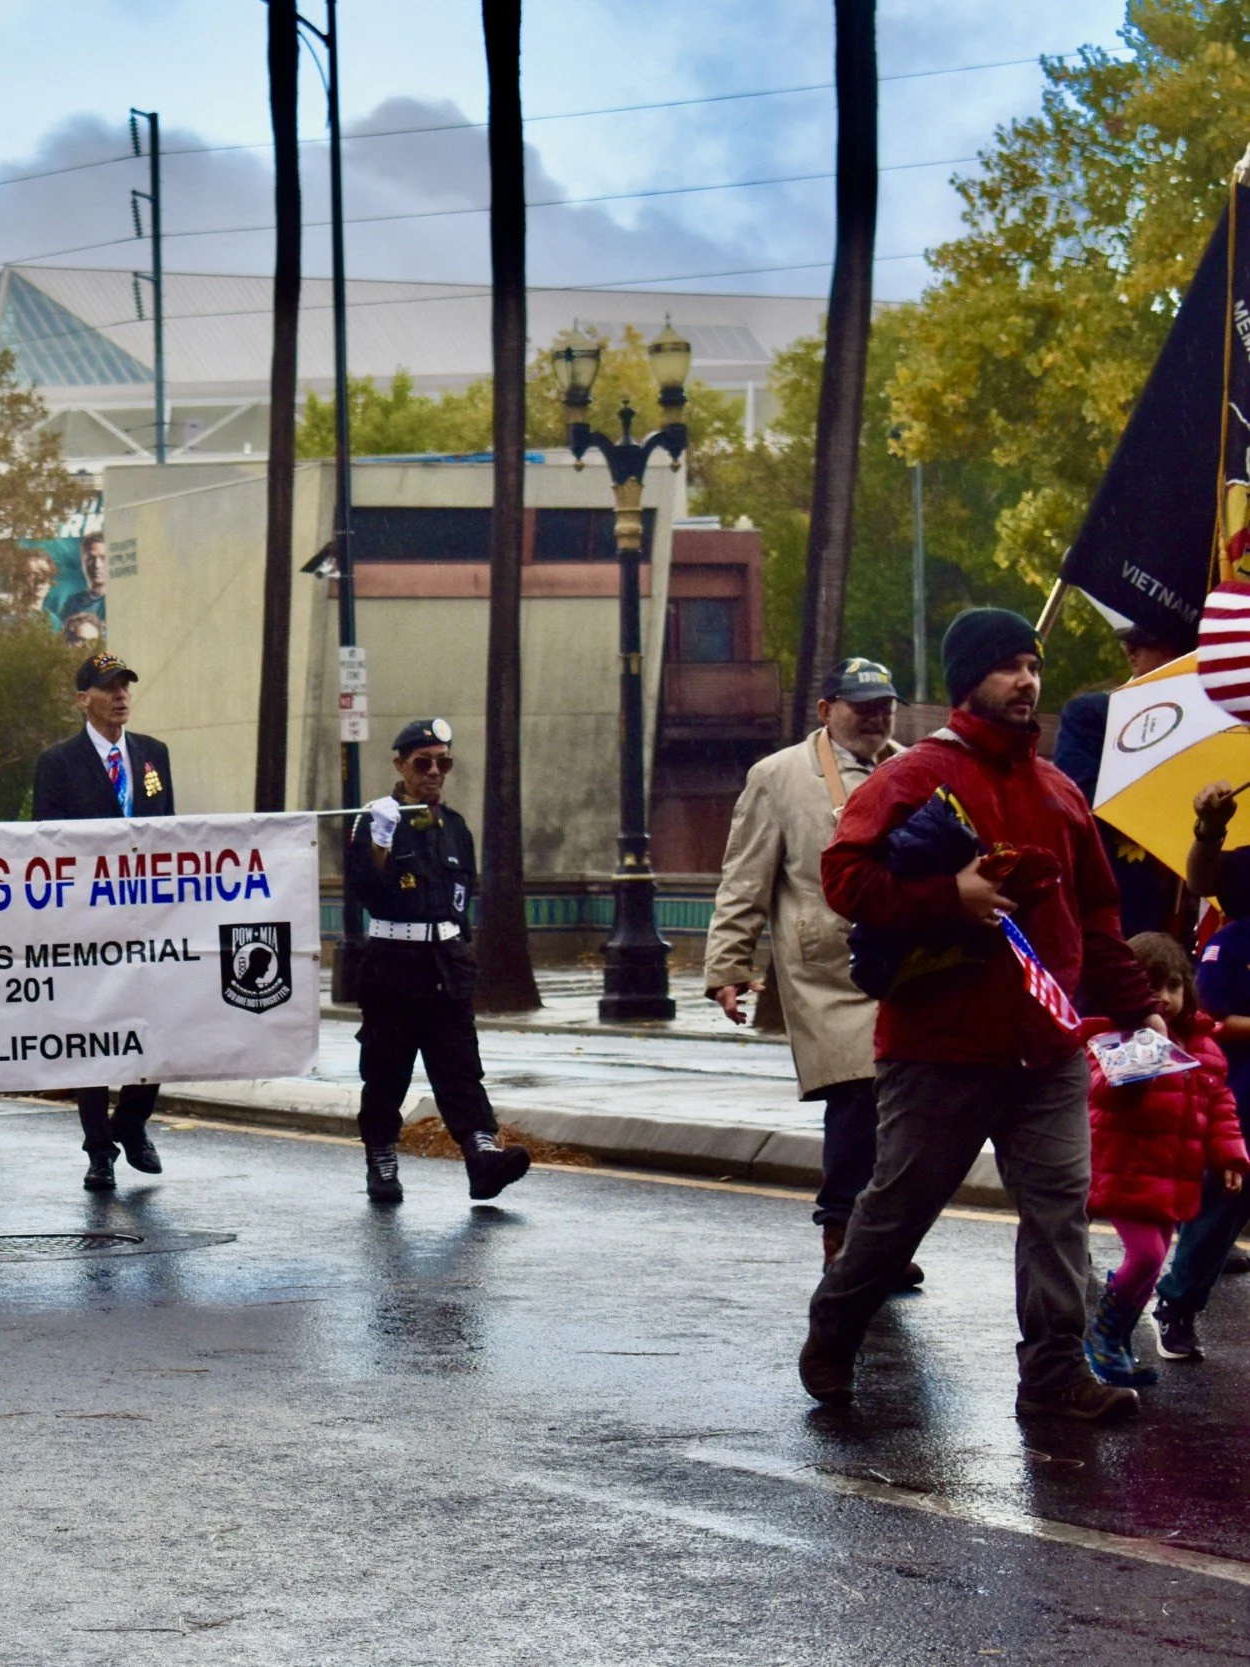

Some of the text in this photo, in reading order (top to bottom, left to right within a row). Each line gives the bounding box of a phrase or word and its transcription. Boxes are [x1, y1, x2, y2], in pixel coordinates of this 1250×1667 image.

[1121, 560, 1199, 624] VIETNAM
[24, 855, 77, 911] OF
[88, 847, 272, 908] AMERICA
[24, 937, 201, 969] MEMORIAL
[232, 926, 279, 957] POW MIA
[5, 976, 55, 1003] 201
